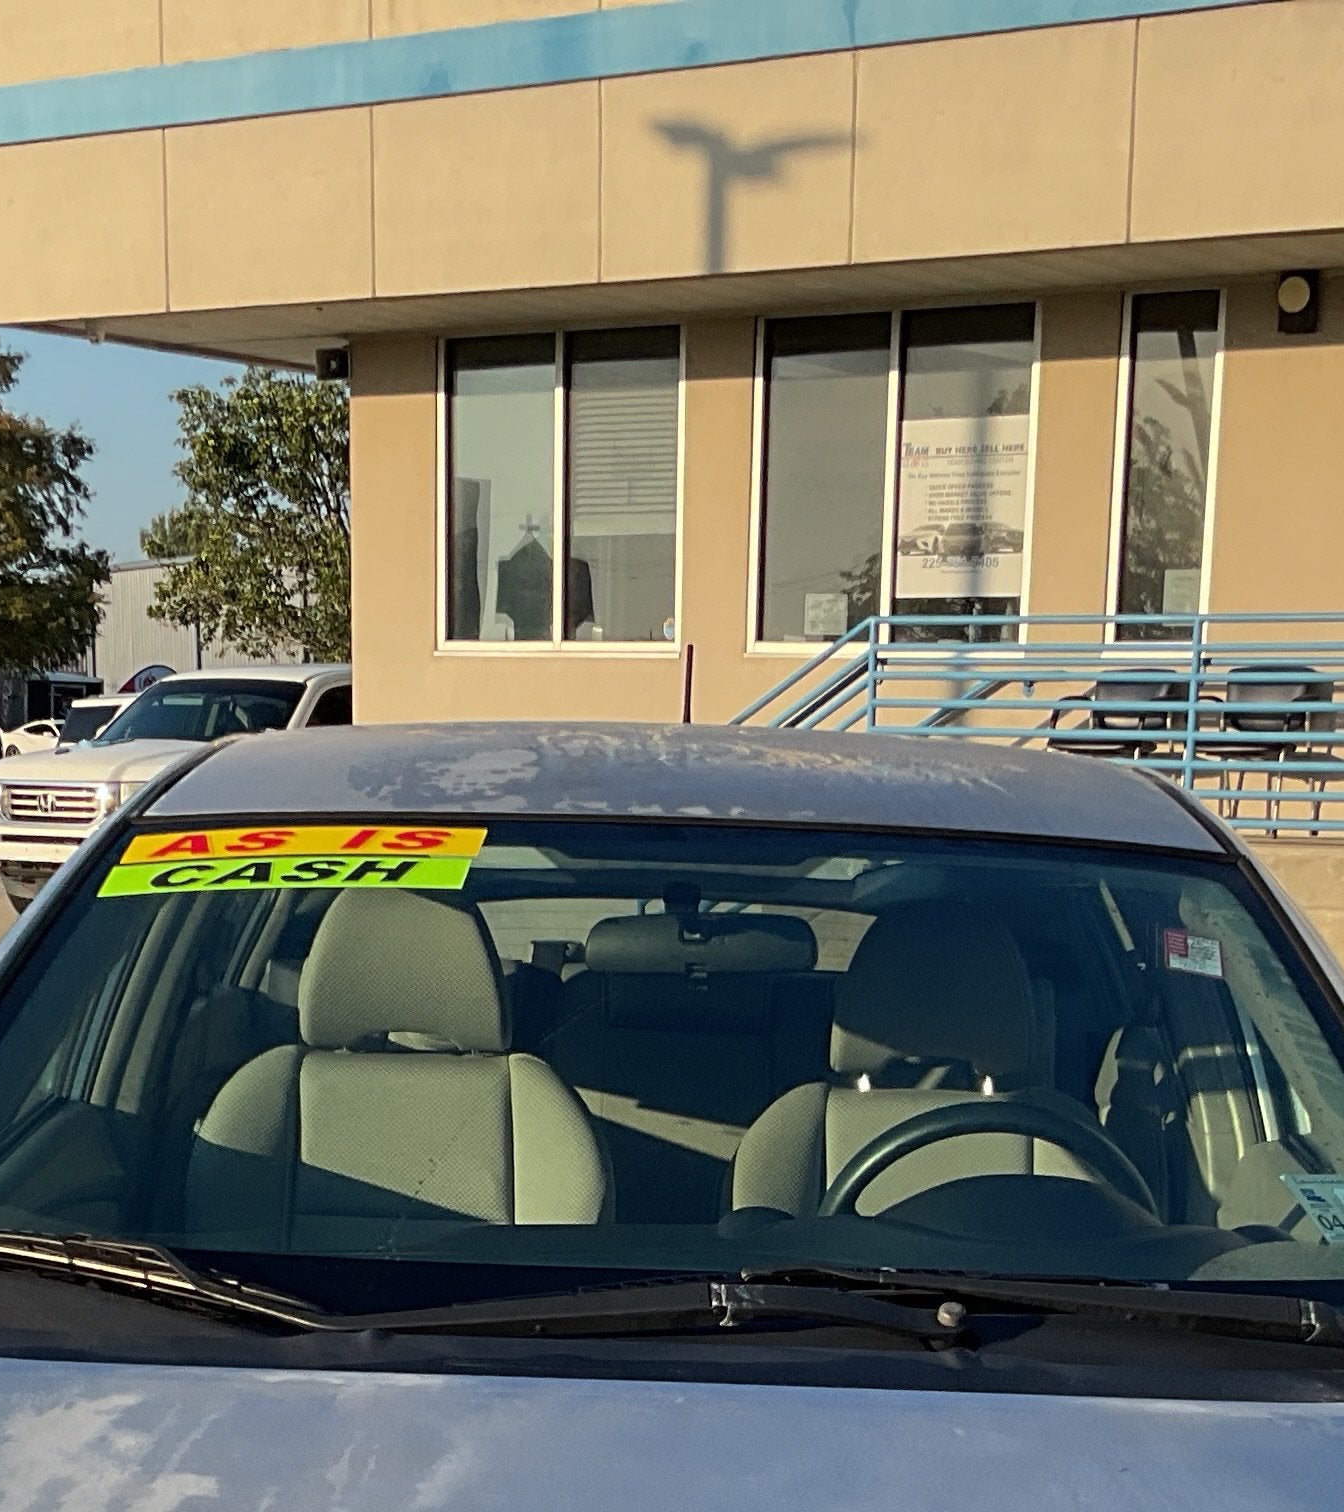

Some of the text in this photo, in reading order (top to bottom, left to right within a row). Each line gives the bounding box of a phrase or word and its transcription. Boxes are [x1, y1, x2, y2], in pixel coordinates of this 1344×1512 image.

[935, 446, 953, 455] BUY
[151, 828, 455, 857] AS IS
[150, 860, 418, 888] CASH
